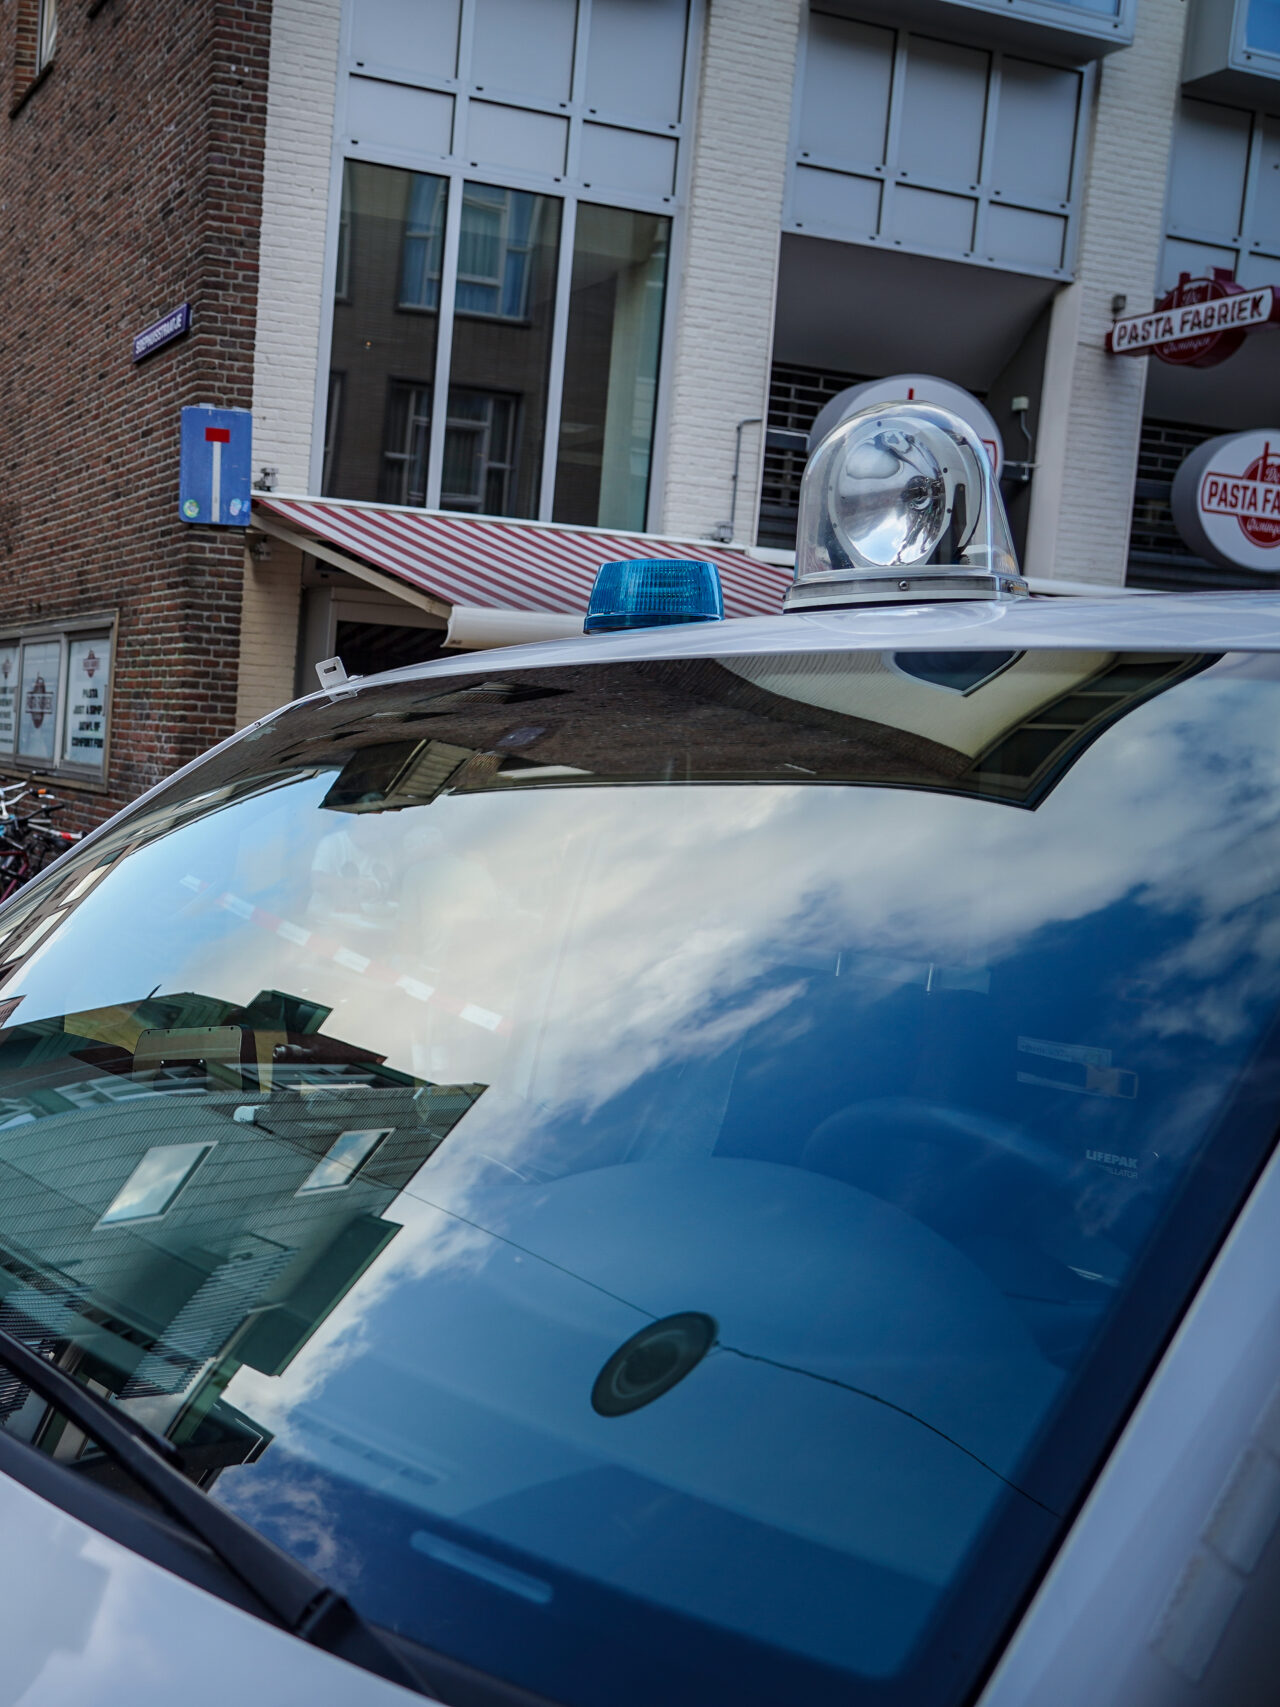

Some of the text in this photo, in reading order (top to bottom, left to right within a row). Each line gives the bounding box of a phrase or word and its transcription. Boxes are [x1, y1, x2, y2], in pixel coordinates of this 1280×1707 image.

[1116, 293, 1264, 347] PASTA FABRIEK
[1207, 481, 1259, 512] PASTA
[1085, 1149, 1138, 1169] LIFEPAK
